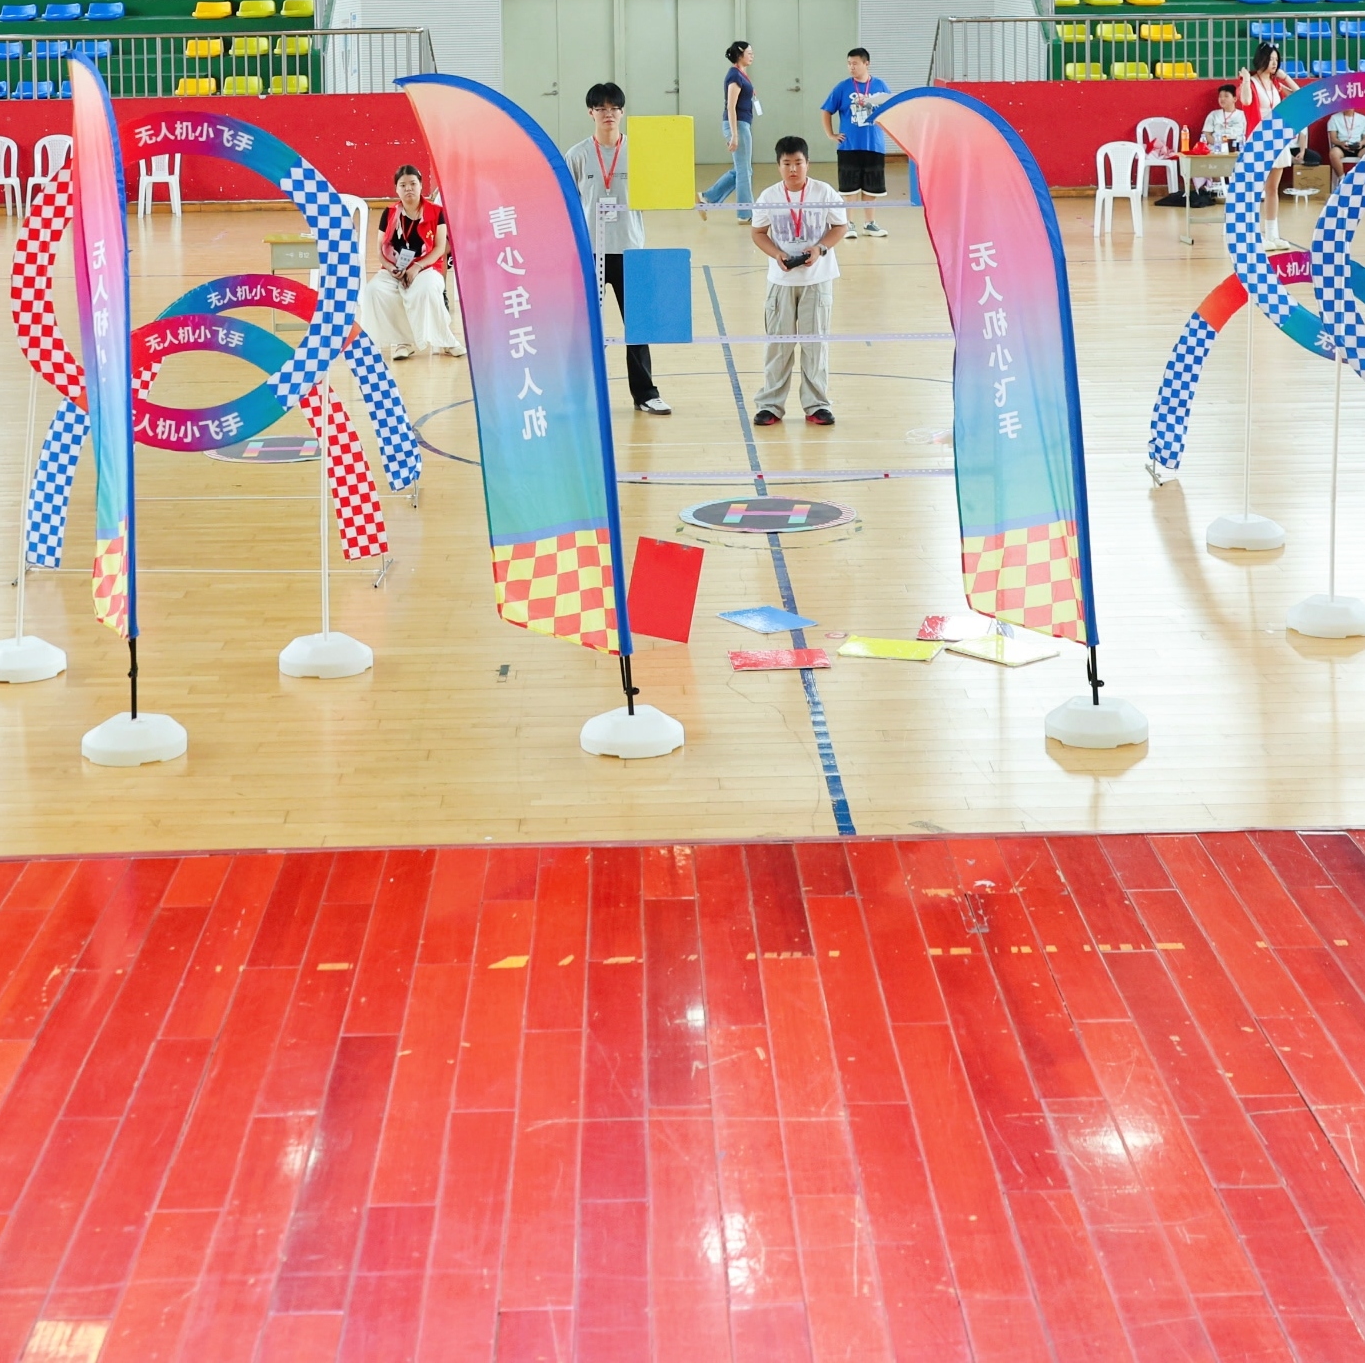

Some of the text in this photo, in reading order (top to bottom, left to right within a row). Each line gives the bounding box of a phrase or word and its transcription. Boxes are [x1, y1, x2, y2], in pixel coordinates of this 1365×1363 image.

[134, 120, 255, 151] 无人机小飞手
[1276, 261, 1311, 277] 人机小
[207, 284, 297, 309] 无人机小飞手
[144, 326, 245, 353] 无人机小飞手
[133, 411, 245, 443] 人机小飞手
